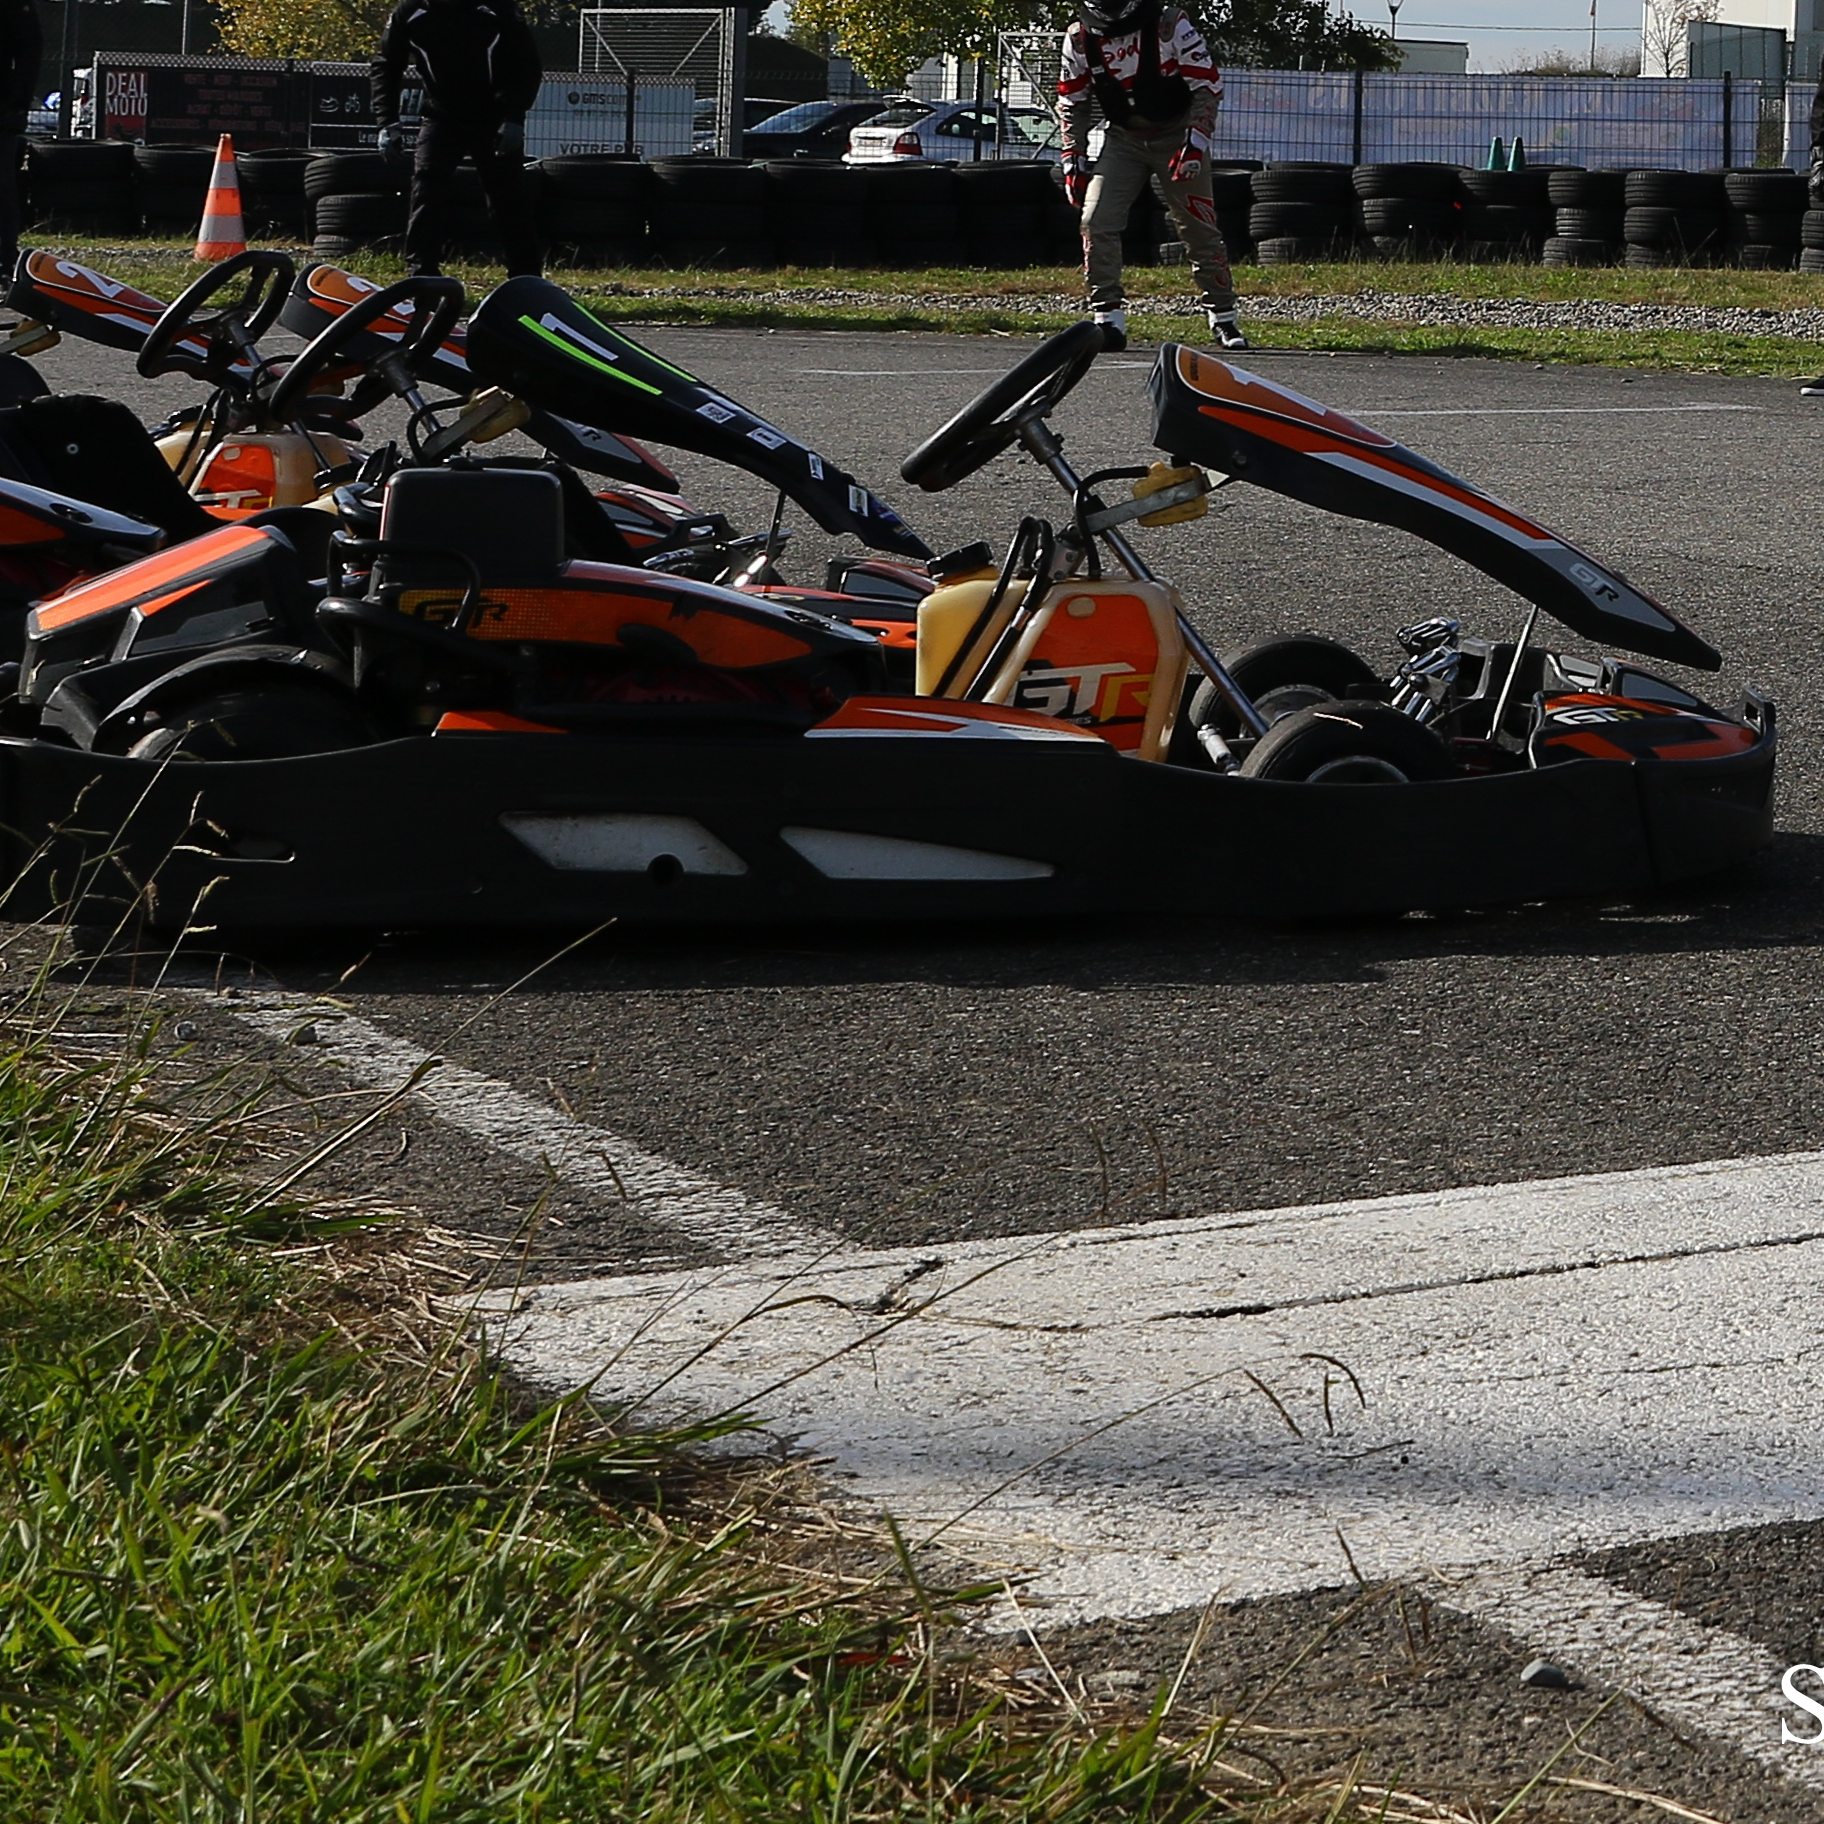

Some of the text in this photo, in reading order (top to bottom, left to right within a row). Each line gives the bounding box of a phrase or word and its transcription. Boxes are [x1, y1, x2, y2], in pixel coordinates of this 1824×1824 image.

[105, 71, 148, 97] DEAL
[106, 97, 148, 117] MOTO
[614, 145, 645, 156] PB
[55, 259, 125, 299] 2
[1568, 561, 1620, 603] GTR
[1008, 661, 1155, 722] GTR
[1551, 706, 1645, 725] GTR
